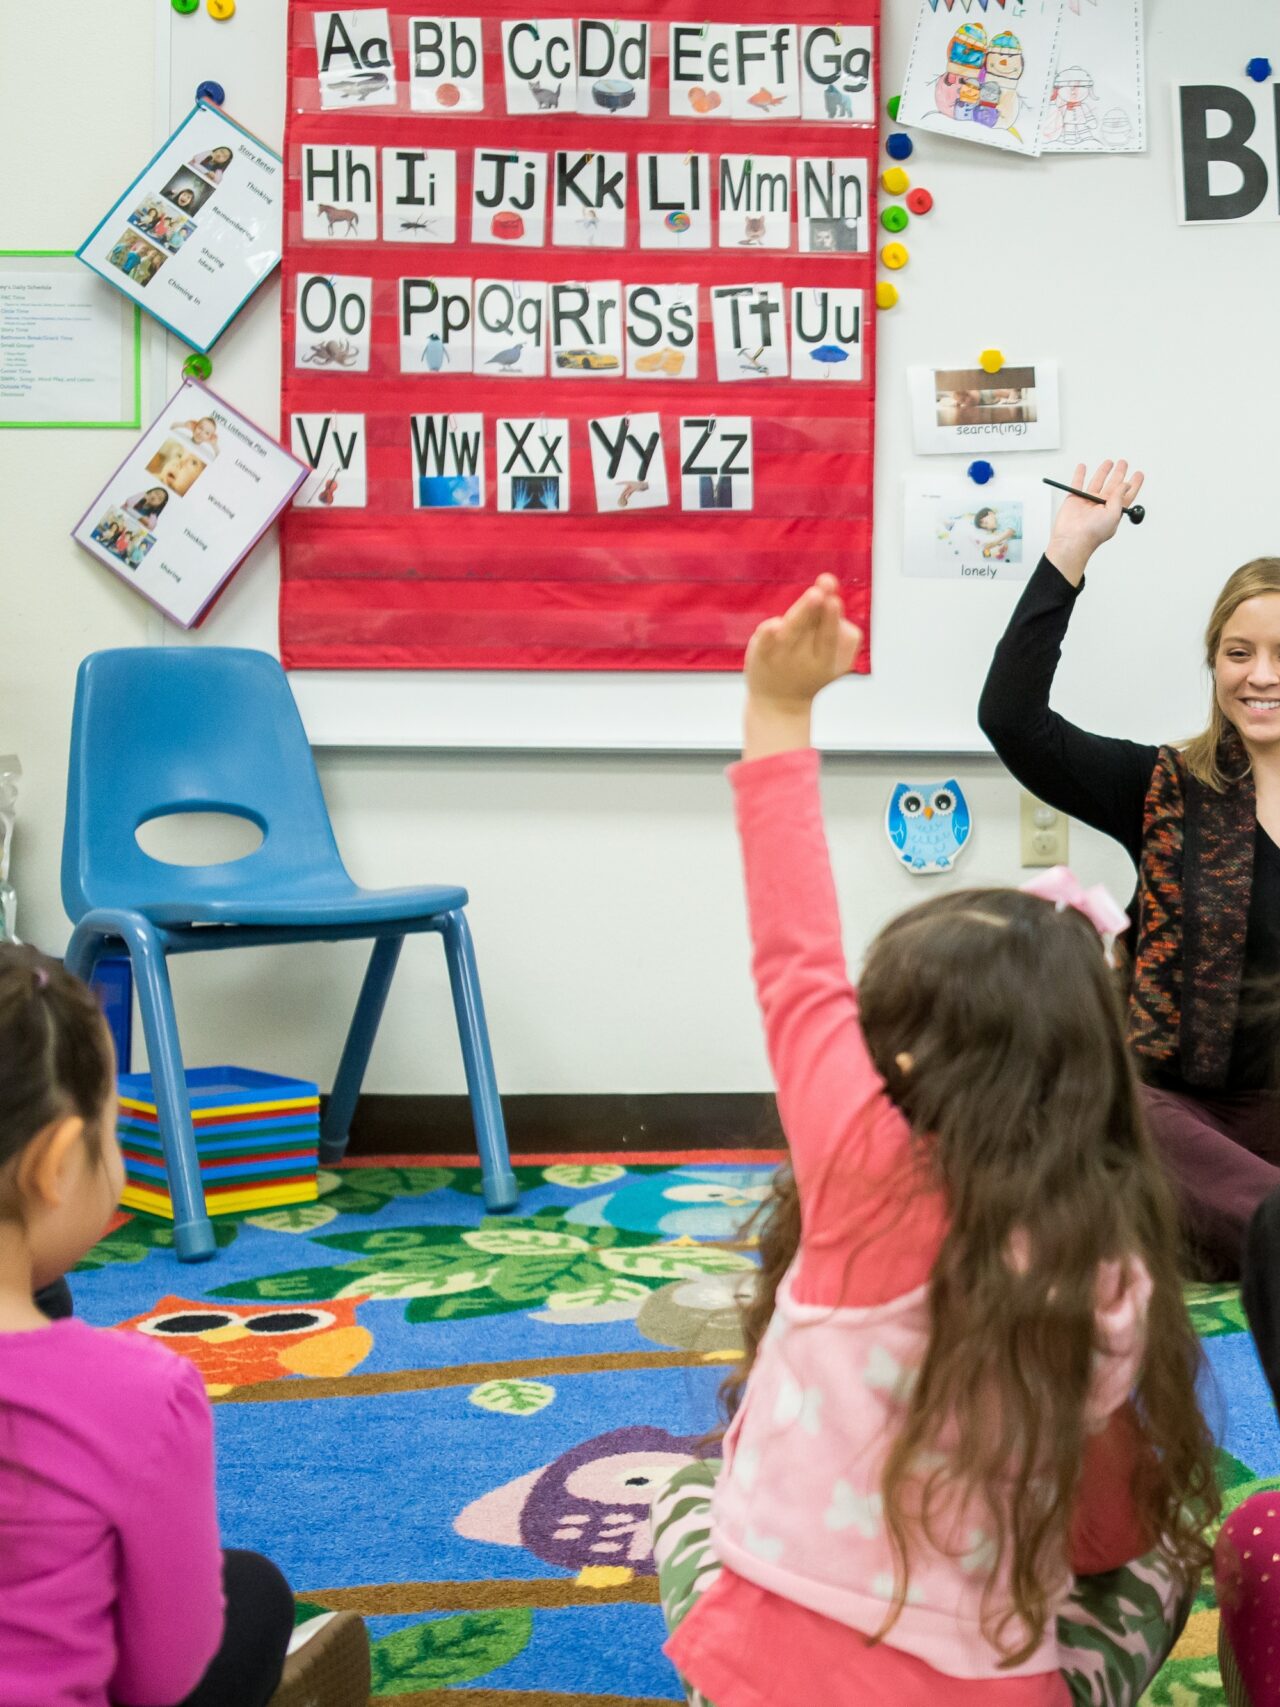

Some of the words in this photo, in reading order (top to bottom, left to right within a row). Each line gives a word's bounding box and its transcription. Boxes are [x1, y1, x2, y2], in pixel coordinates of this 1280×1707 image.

[321, 13, 391, 72] Aa
[413, 21, 477, 78] Bb
[507, 23, 571, 80] Cc
[578, 20, 647, 80] Dd
[673, 27, 730, 82] Ee
[735, 28, 790, 86] Ff
[803, 27, 871, 93] Gg
[247, 181, 273, 205] Thinking
[306, 149, 371, 202] Hh
[396, 152, 436, 206] Ii
[475, 153, 535, 210] Jj
[557, 152, 624, 209] Kk
[648, 156, 700, 211] Ll
[720, 159, 788, 212] Mm
[804, 161, 862, 218] Nn
[200, 247, 225, 269] Sharing
[300, 276, 366, 336] Oo
[402, 279, 470, 344] Pp
[478, 284, 542, 347] Qq
[552, 285, 617, 346] Rr
[627, 286, 694, 347] Ss
[714, 288, 780, 349] Tt
[796, 291, 859, 343] Uu
[296, 418, 358, 470] Vv
[411, 416, 481, 477] Ww
[502, 422, 563, 474] Xx
[590, 417, 660, 482] Yy
[682, 419, 750, 475] Zz
[956, 422, 1028, 436] search(ing)
[961, 565, 997, 579] lonely
